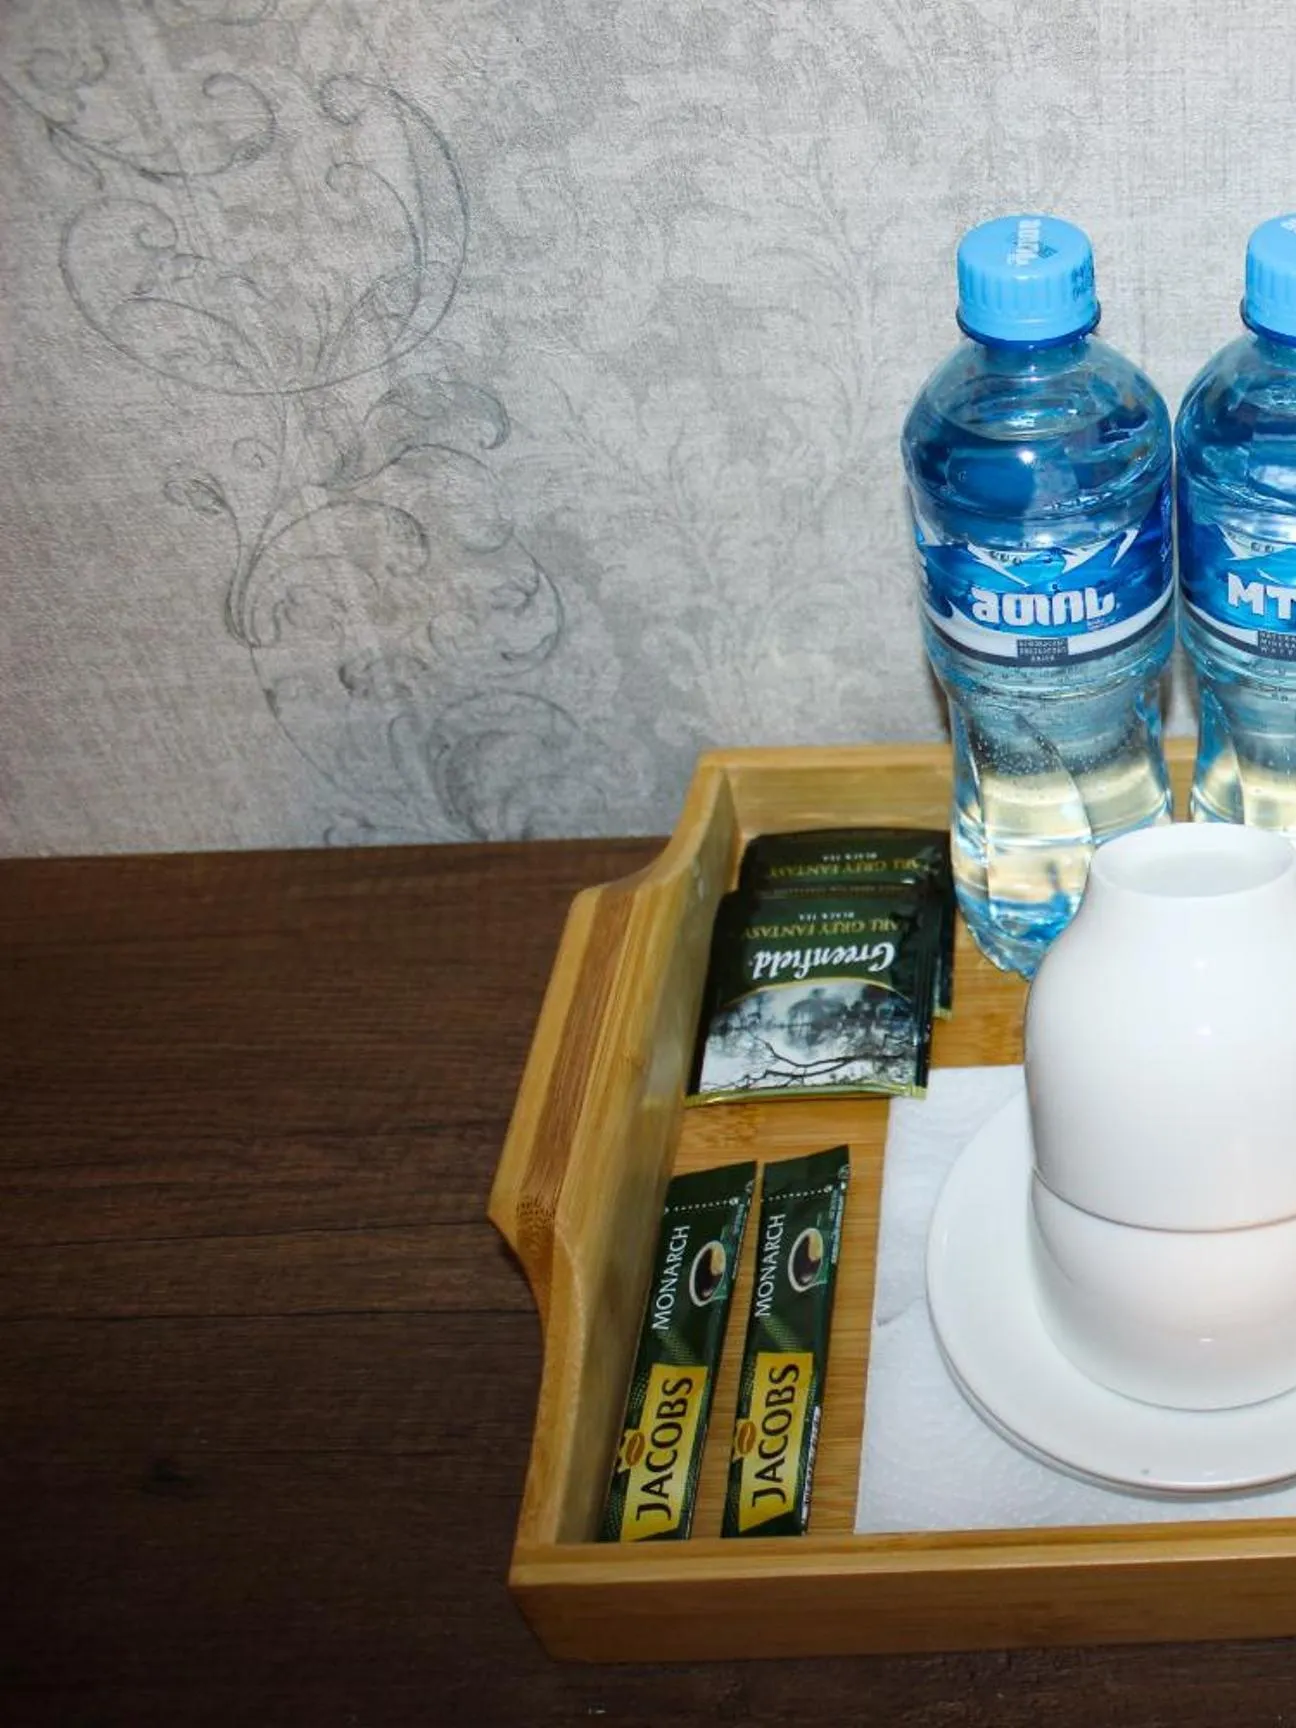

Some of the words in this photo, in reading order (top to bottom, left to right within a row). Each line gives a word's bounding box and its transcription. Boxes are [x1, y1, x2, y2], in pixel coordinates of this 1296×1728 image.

[741, 922, 815, 941] FANTASY
[750, 941, 896, 981] Greenfield
[818, 920, 865, 936] GREY
[651, 1224, 691, 1331] MONARCH
[754, 1213, 787, 1318] MONARCH
[635, 1376, 693, 1521] JACOBS
[751, 1362, 800, 1509] JACOBS
